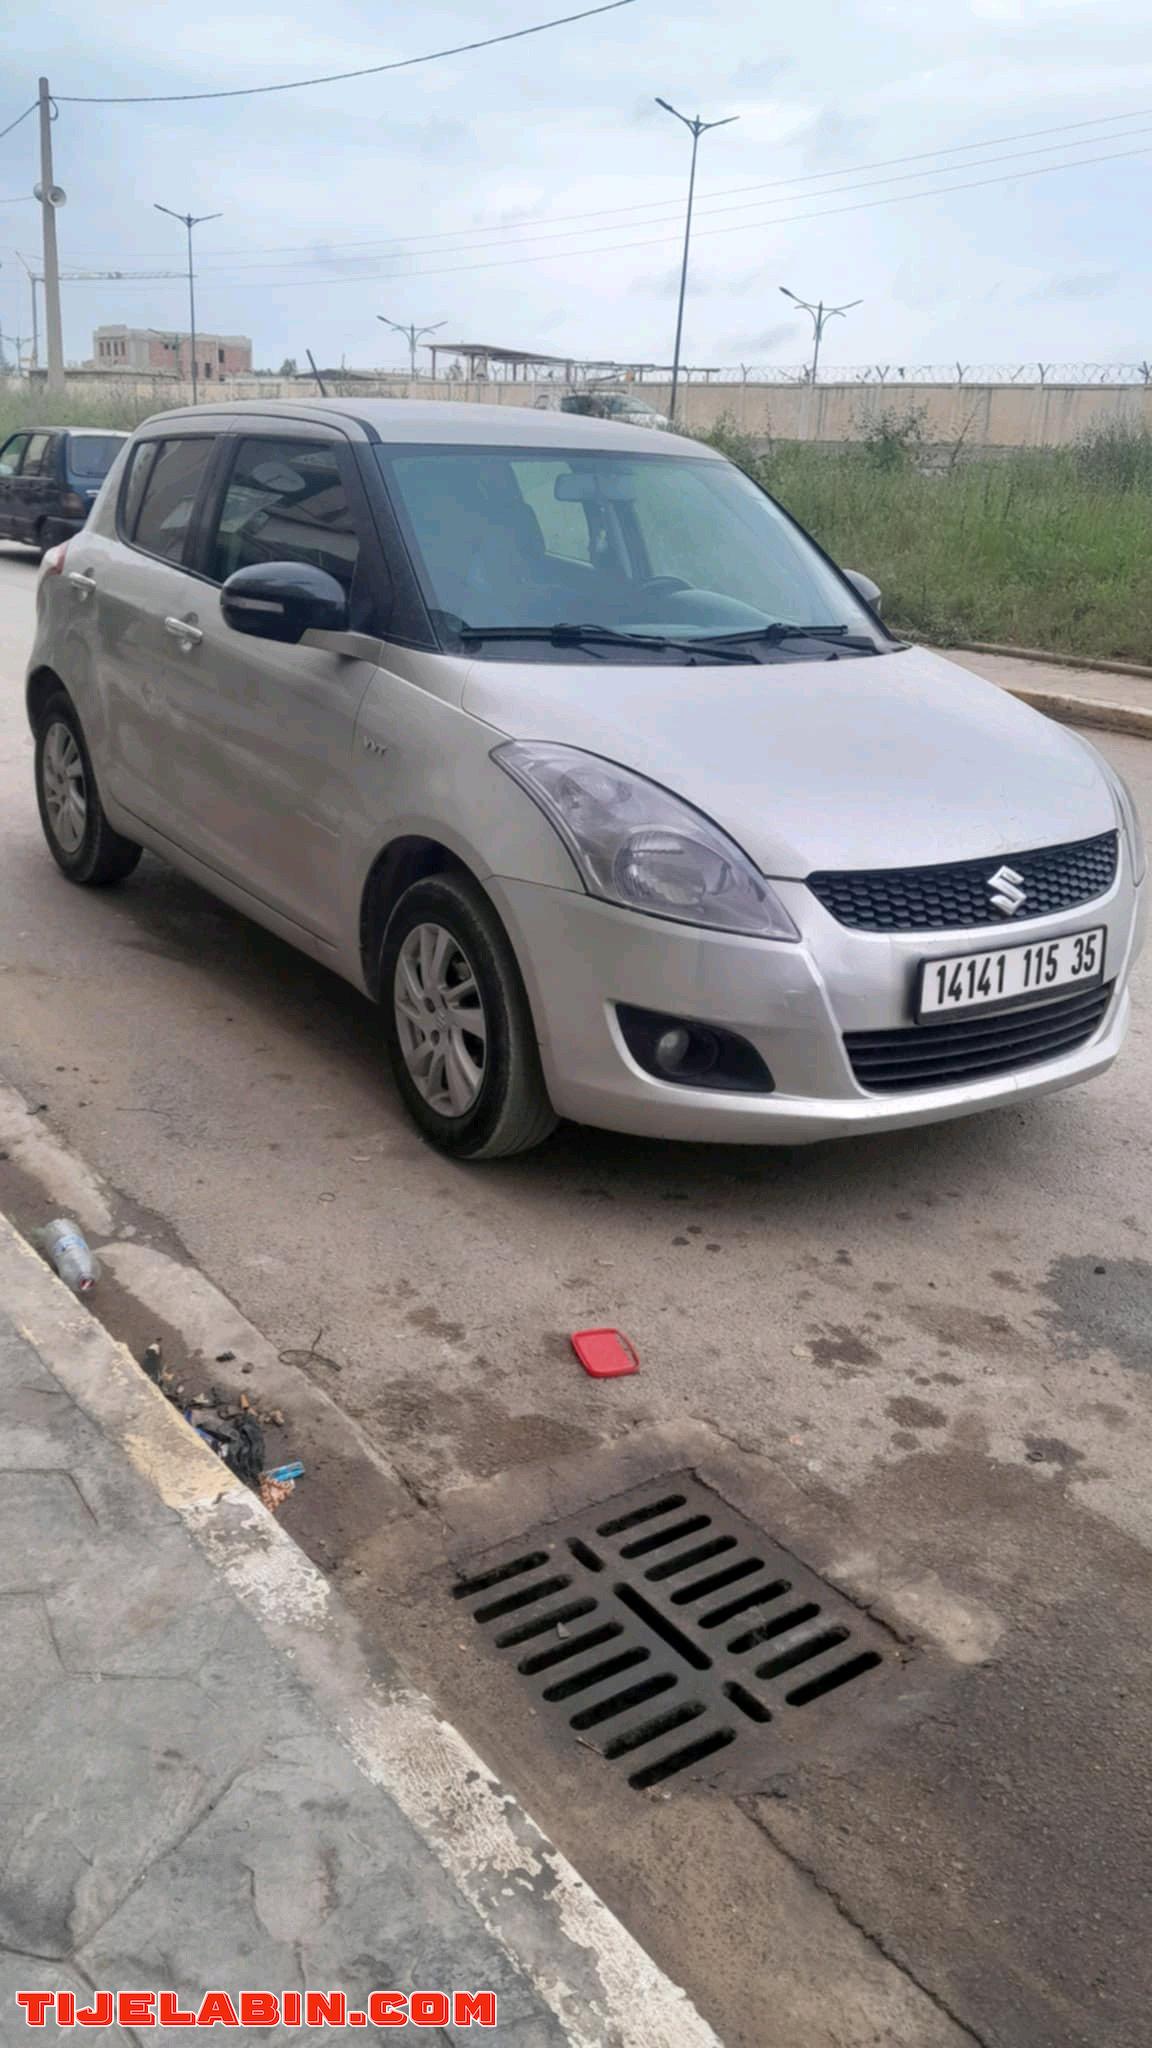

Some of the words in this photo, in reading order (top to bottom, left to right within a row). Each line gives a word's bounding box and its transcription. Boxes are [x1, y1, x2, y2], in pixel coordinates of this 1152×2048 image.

[936, 954, 1006, 1004] 14141
[1023, 944, 1059, 987] 115
[1071, 935, 1097, 975] 35
